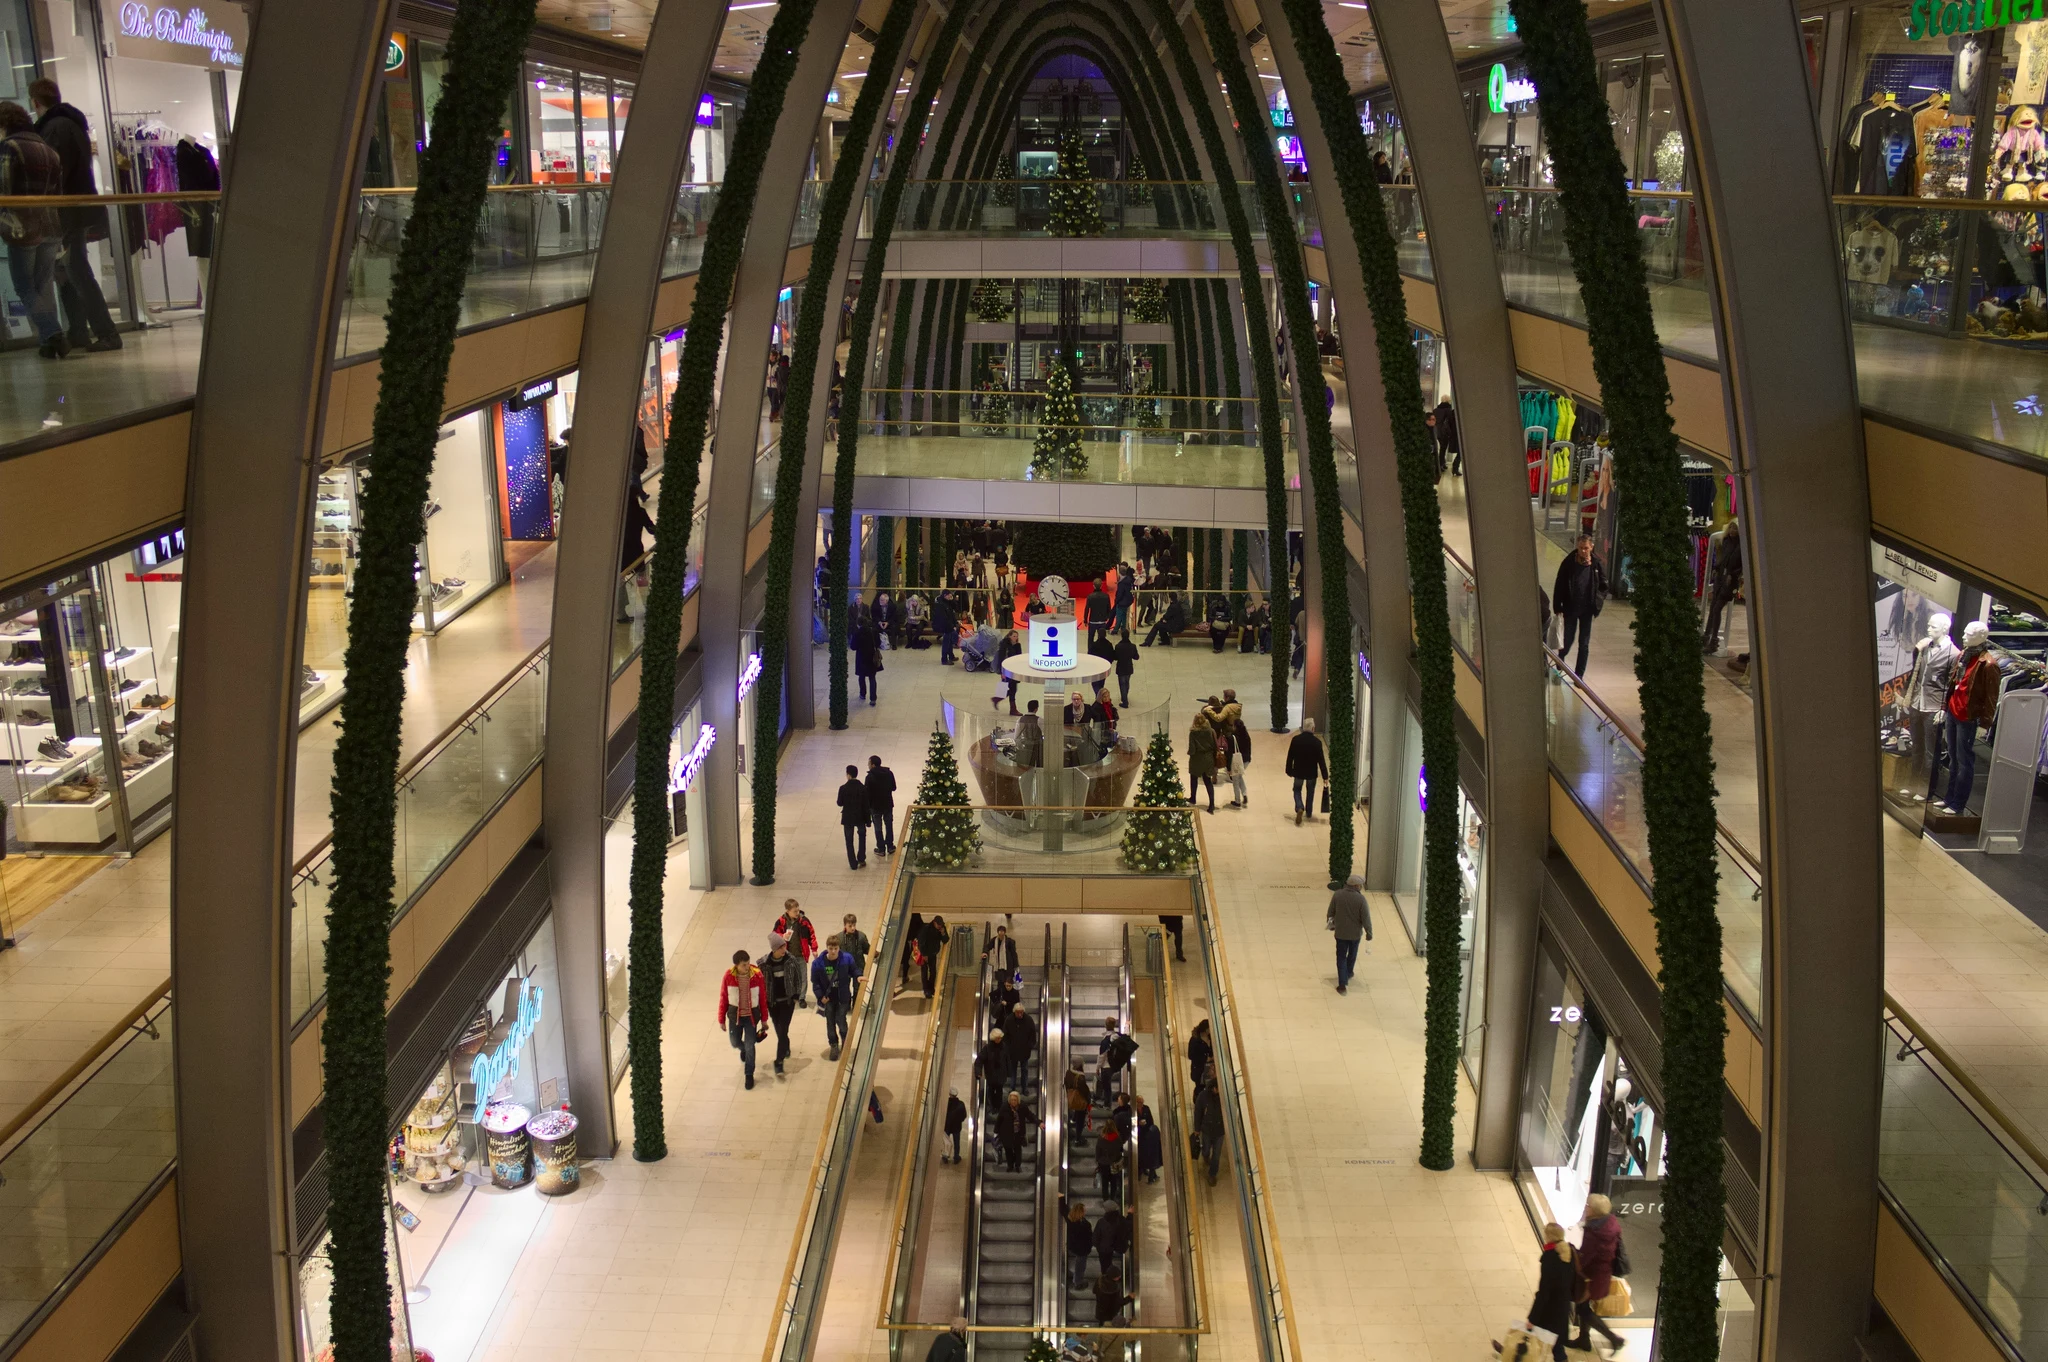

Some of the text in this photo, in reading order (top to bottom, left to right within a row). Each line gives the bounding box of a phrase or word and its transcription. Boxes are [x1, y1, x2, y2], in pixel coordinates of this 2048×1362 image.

[1033, 658, 1073, 667] INFOPOINT
[1359, 651, 1371, 682] PILG
[1549, 1006, 1587, 1022] ze
